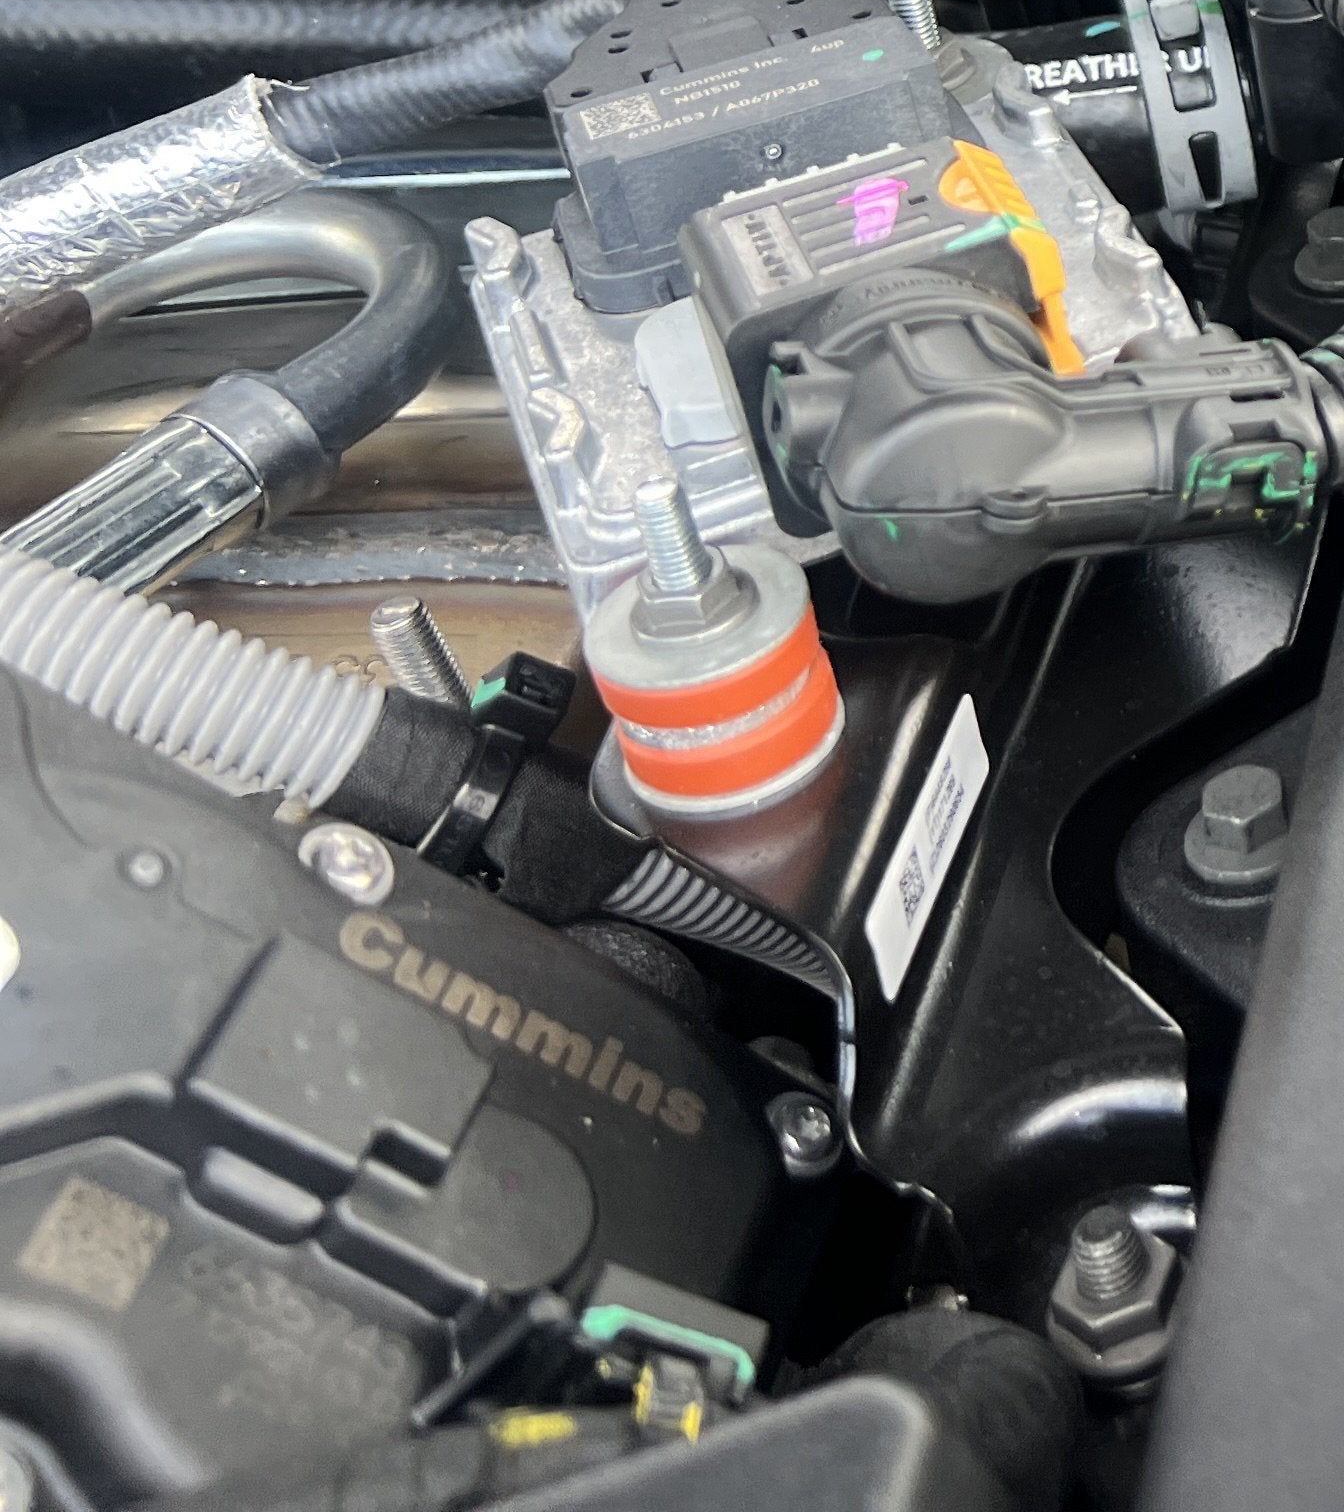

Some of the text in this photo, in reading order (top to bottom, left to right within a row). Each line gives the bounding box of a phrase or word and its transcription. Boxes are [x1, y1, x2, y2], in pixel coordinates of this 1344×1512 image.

[659, 65, 750, 97] Cummins
[754, 55, 788, 72] Inc.
[339, 911, 707, 1136] Cummins
